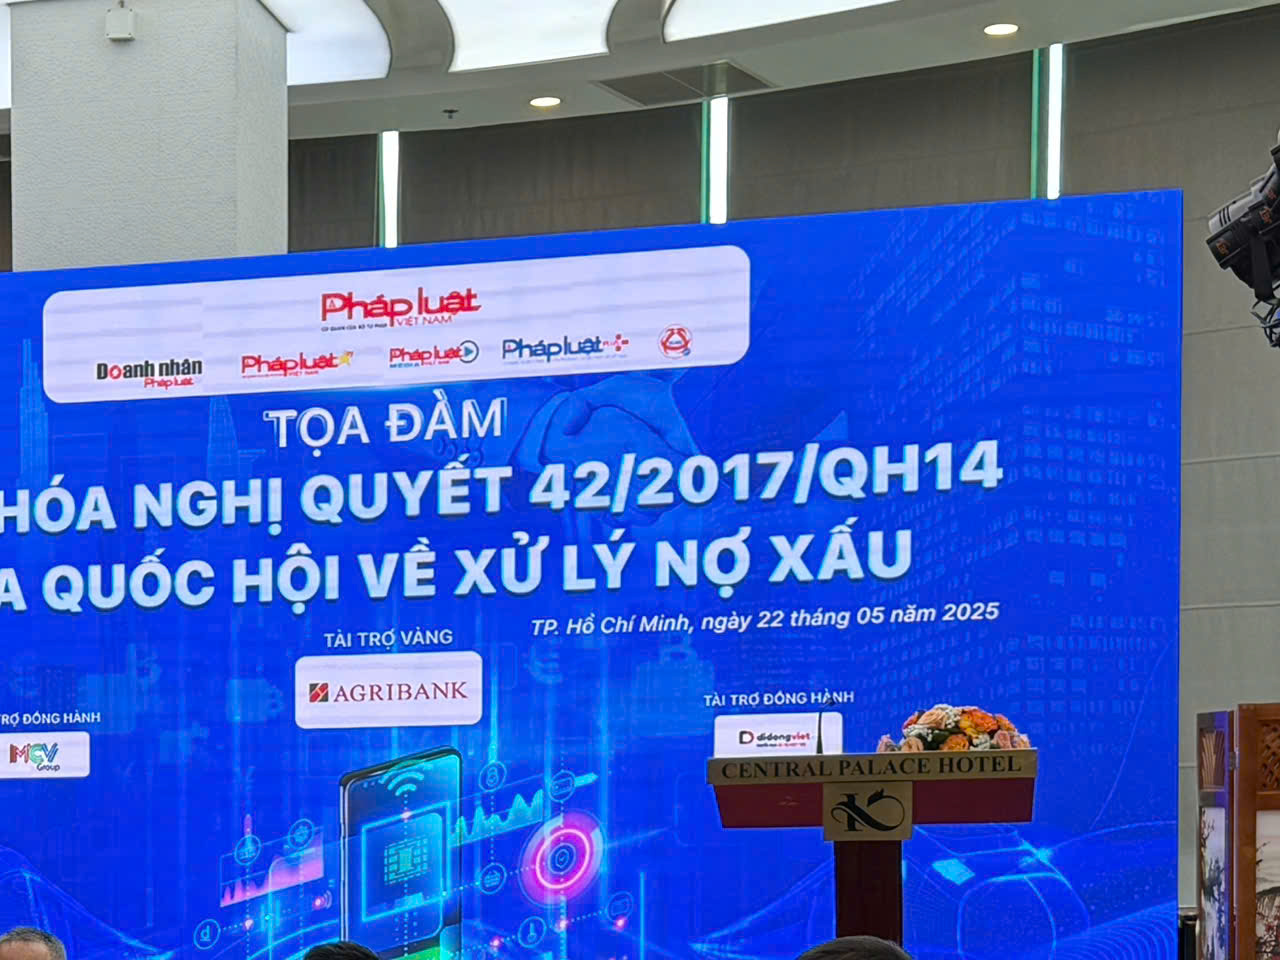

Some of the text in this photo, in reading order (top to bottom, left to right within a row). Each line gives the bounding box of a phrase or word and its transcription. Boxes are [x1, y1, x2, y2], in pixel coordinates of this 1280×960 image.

[321, 287, 482, 327] Pháp luật
[396, 315, 453, 327] VIỆT NAM
[389, 345, 463, 366] Pháp luật
[502, 338, 563, 363] Pháp
[564, 335, 604, 356] luật
[97, 358, 202, 380] Doanh nhân
[241, 352, 339, 377] Pháp luật
[144, 376, 194, 390] Pháp luật
[263, 389, 508, 457] TỌA ĐÀM
[133, 477, 283, 536] NGHỊ
[300, 454, 513, 525] QUYẾT
[528, 440, 1003, 513] 42/2017/QH14
[42, 548, 215, 613] QUỐC
[232, 543, 340, 615] HỘI
[357, 537, 437, 600] VỀ
[454, 531, 550, 596] XỬ
[562, 528, 636, 592] LÝ
[656, 527, 751, 598] NỢ
[768, 516, 912, 584] XẤU
[531, 602, 1000, 636] TP. Hồ Chí Minh, ngày 22 tháng 05 năm 2025
[324, 627, 454, 650] TÀI TRỢ VÀNG
[333, 680, 468, 704] AGRIBANK
[704, 692, 727, 708] TÀI
[729, 692, 759, 708] TRỢ
[810, 689, 855, 705] HÀNH
[22, 710, 61, 726] ĐỒNG
[63, 709, 101, 725] HÀNH
[756, 731, 810, 743] didongviet
[9, 742, 59, 764] MCV
[36, 763, 61, 772] Group
[721, 755, 1022, 779] CENTRAL PALACE HOTEL
